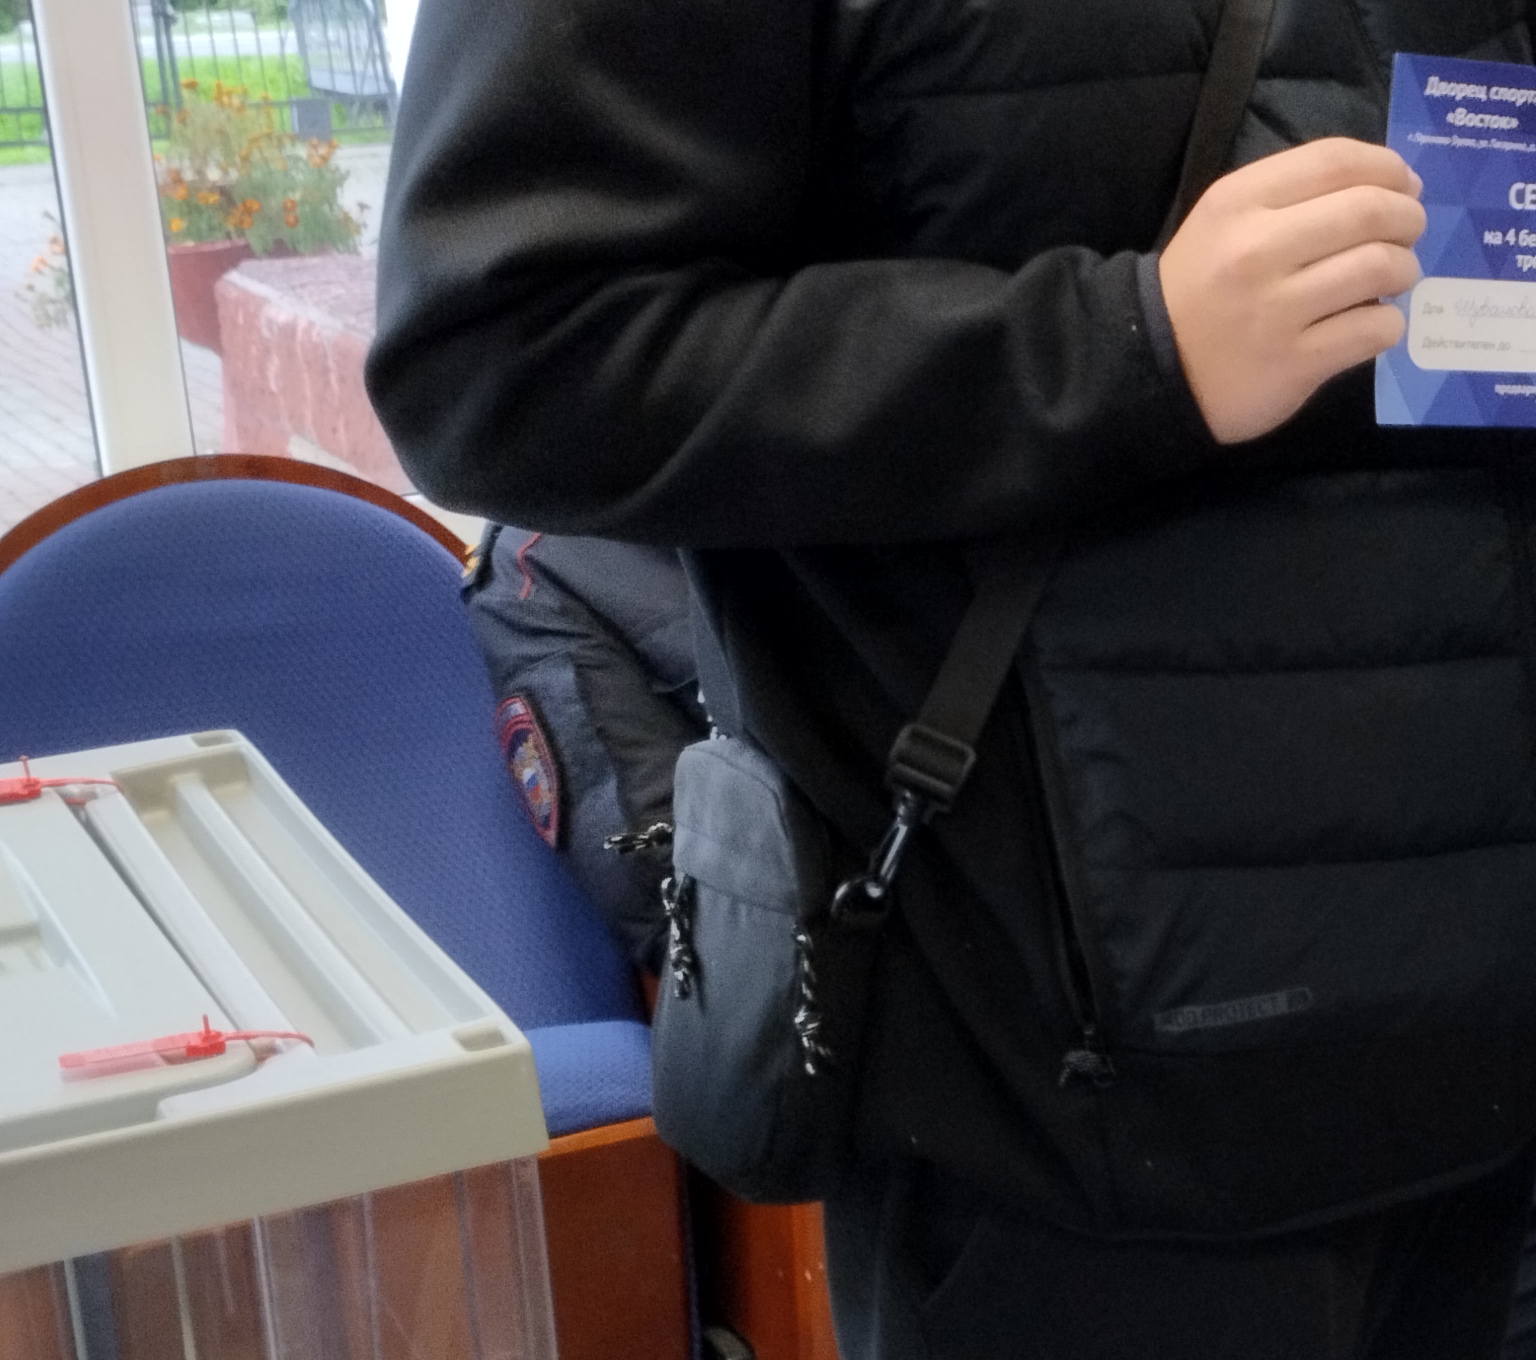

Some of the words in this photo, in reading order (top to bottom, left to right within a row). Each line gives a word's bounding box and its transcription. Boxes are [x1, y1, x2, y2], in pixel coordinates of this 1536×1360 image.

[1424, 75, 1487, 102] Дворец
[1483, 230, 1503, 245] на
[1505, 228, 1516, 245] 4
